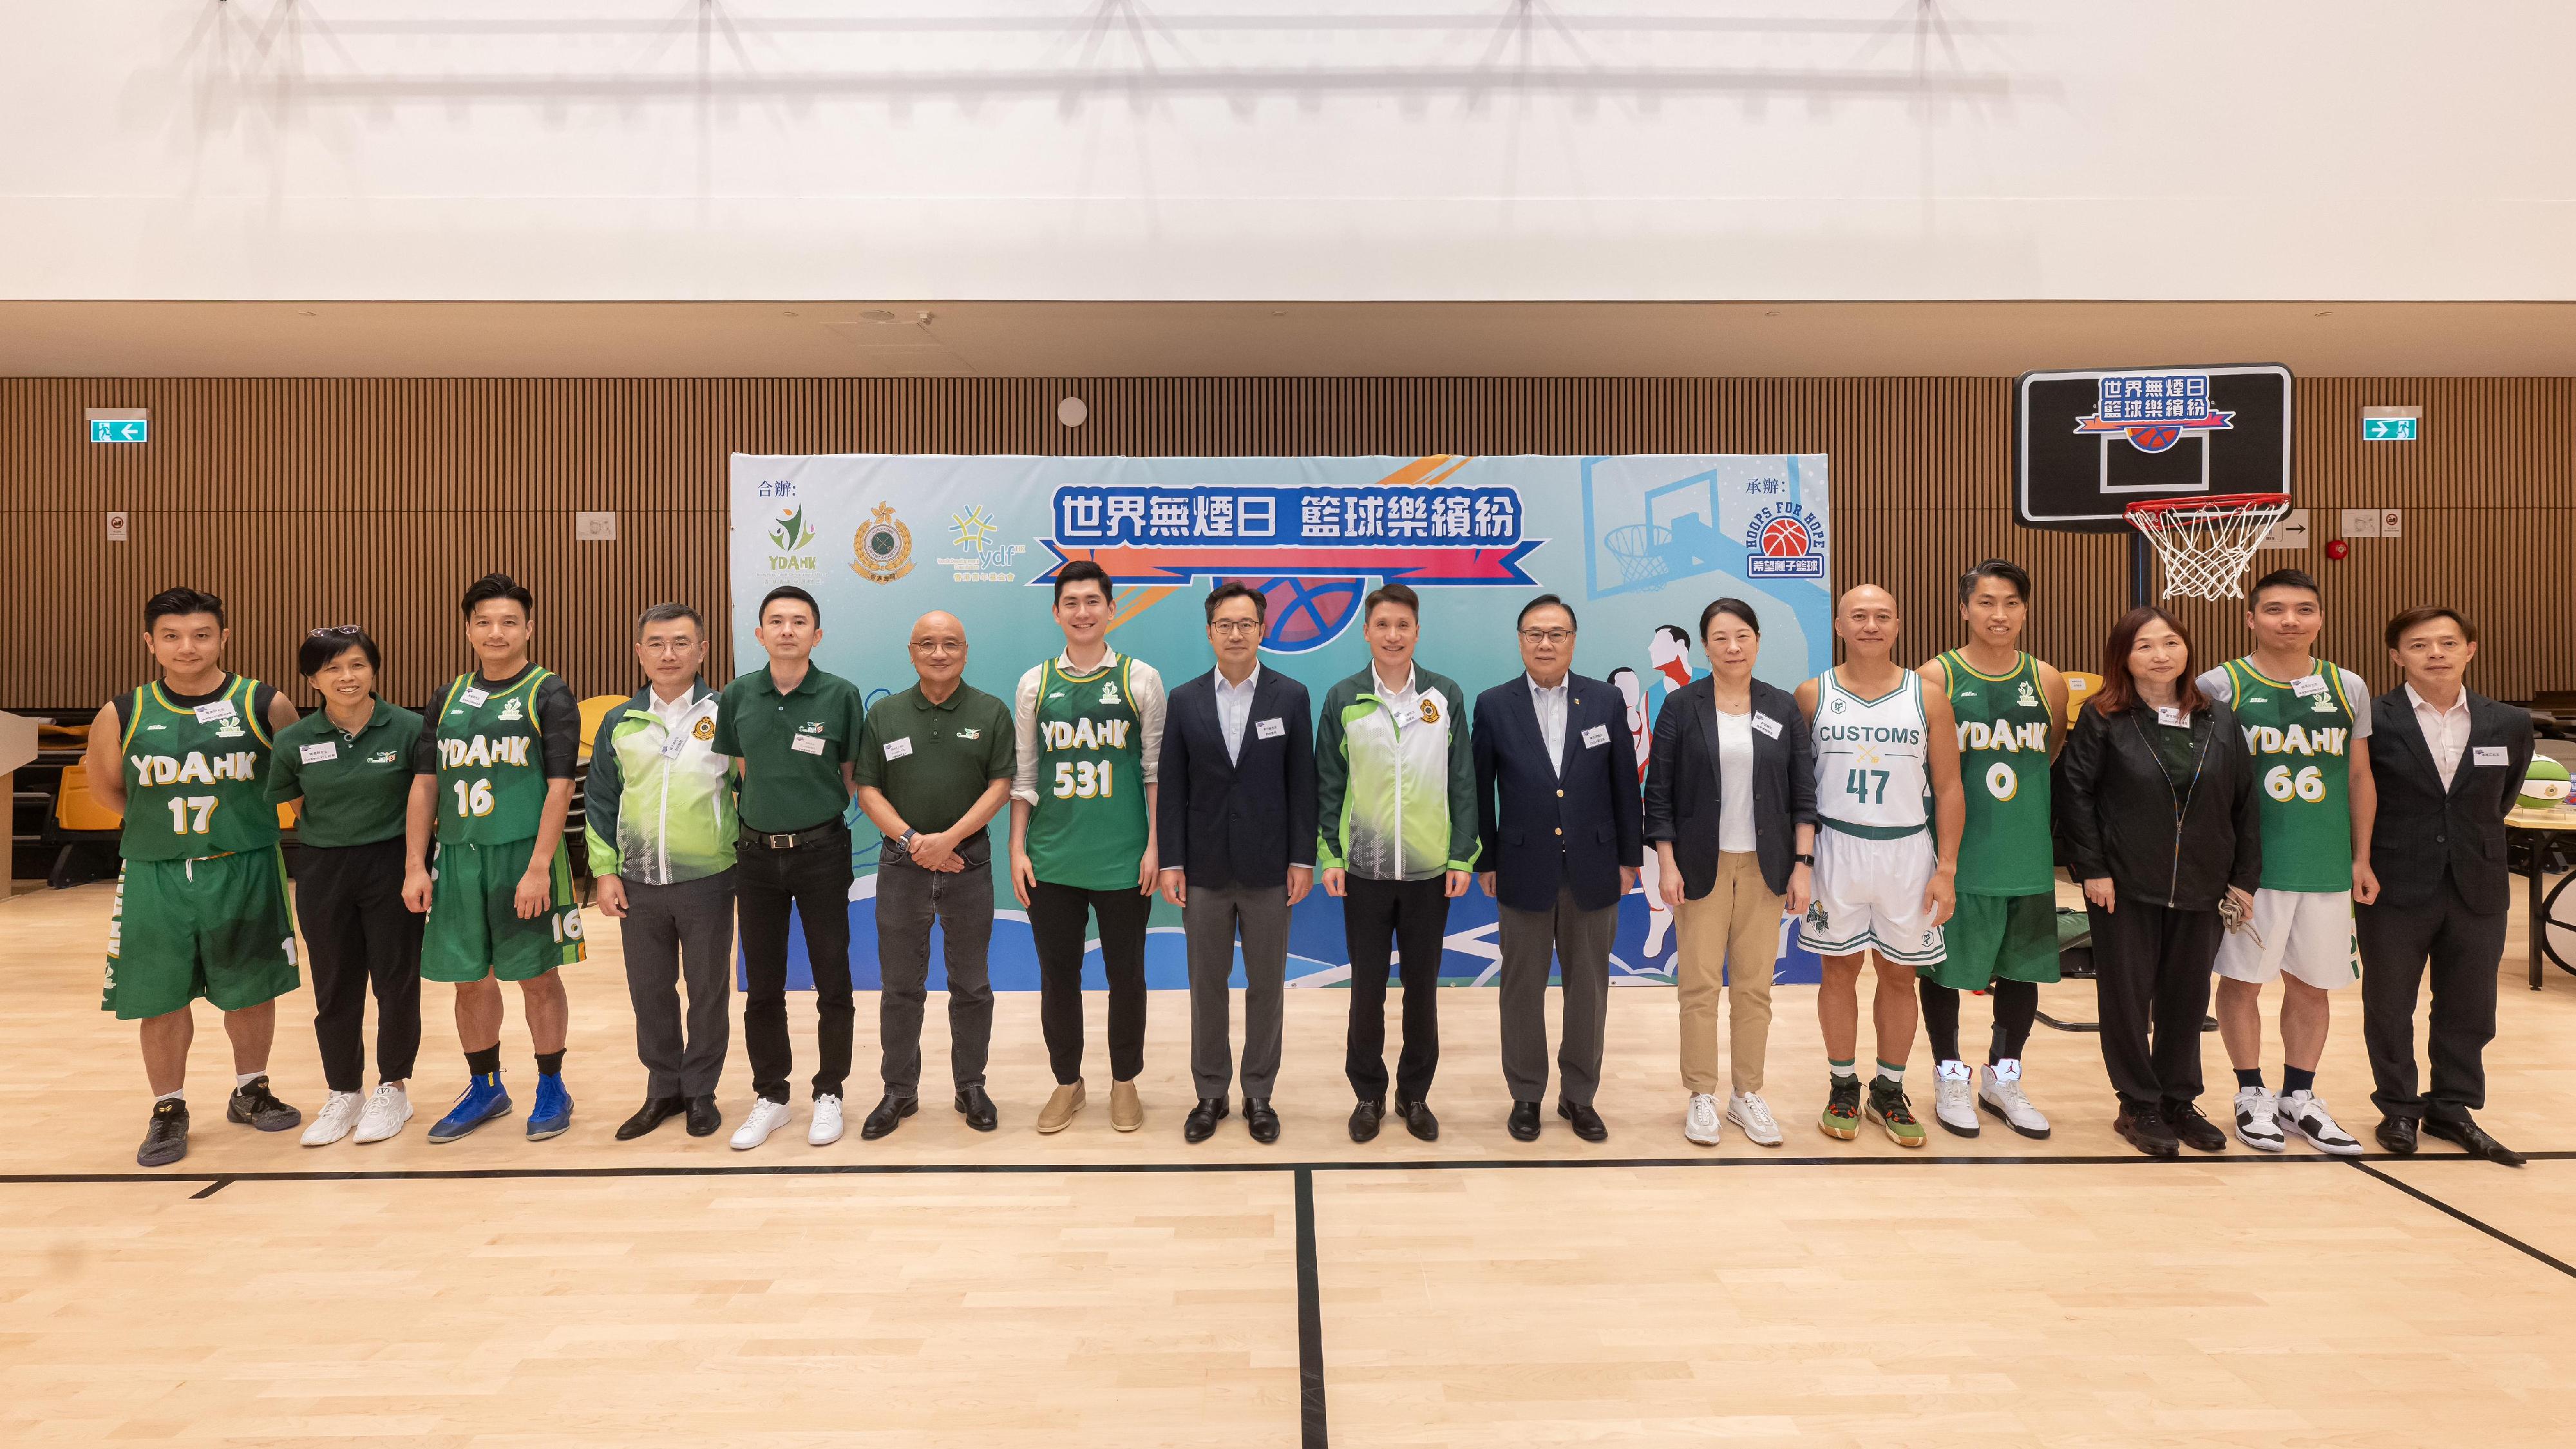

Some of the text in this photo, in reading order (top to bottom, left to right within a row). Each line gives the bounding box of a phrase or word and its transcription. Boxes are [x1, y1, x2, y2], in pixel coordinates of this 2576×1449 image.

[2104, 379, 2204, 398] 世界無煙日
[2104, 399, 2205, 418] 籃球樂繽紛
[1063, 496, 1513, 537] 世界無煙日 籃球樂繽紛
[1747, 502, 1824, 548] HOOPS FOR HOPE
[768, 555, 817, 571] YDAHK
[980, 545, 1015, 569] ydf
[1753, 560, 1818, 572] 希望種子籃球
[1041, 717, 1130, 752] YDAHK
[1820, 725, 1920, 745] CUSTOMS
[1956, 719, 2047, 753] YDAHK
[2242, 723, 2347, 757] YDAHK
[131, 752, 255, 786] YDAHK
[438, 734, 530, 770] YDAHK
[1054, 759, 1112, 799] 531
[1846, 768, 1890, 804] 47
[1986, 762, 2017, 802] 0
[2264, 765, 2325, 802] 66
[168, 795, 218, 834] 17
[453, 778, 495, 817] 16
[552, 909, 583, 943] 16
